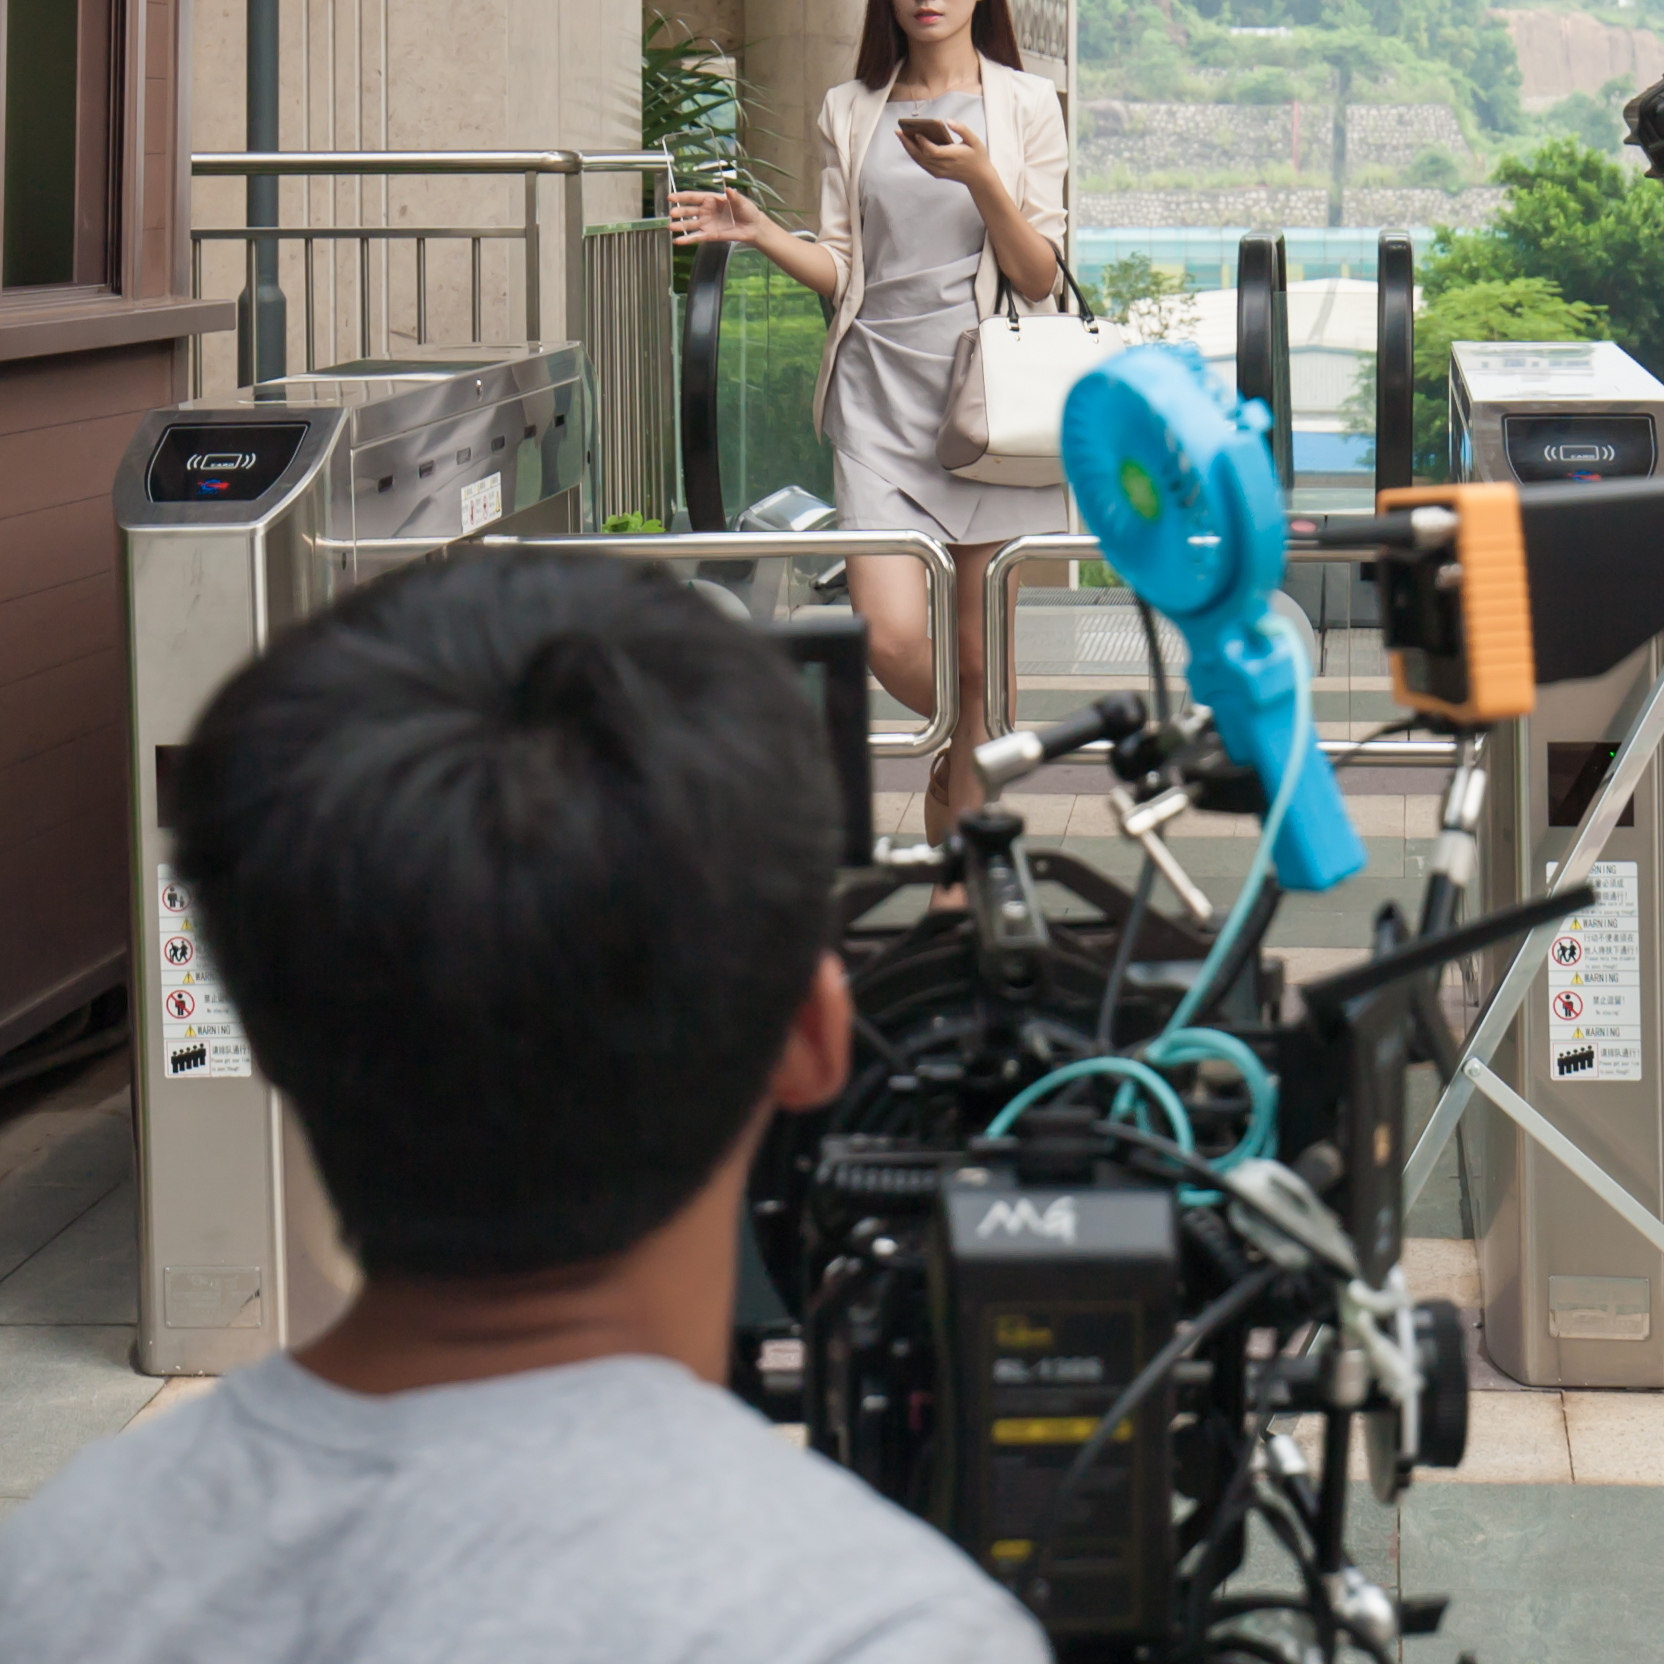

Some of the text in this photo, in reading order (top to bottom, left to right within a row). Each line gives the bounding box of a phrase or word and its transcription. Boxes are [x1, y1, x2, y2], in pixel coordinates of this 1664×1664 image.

[1583, 919, 1618, 928] WARNING
[1584, 973, 1619, 982] WARNING
[197, 1025, 231, 1035] WARNING
[1585, 1027, 1620, 1037] WARNING
